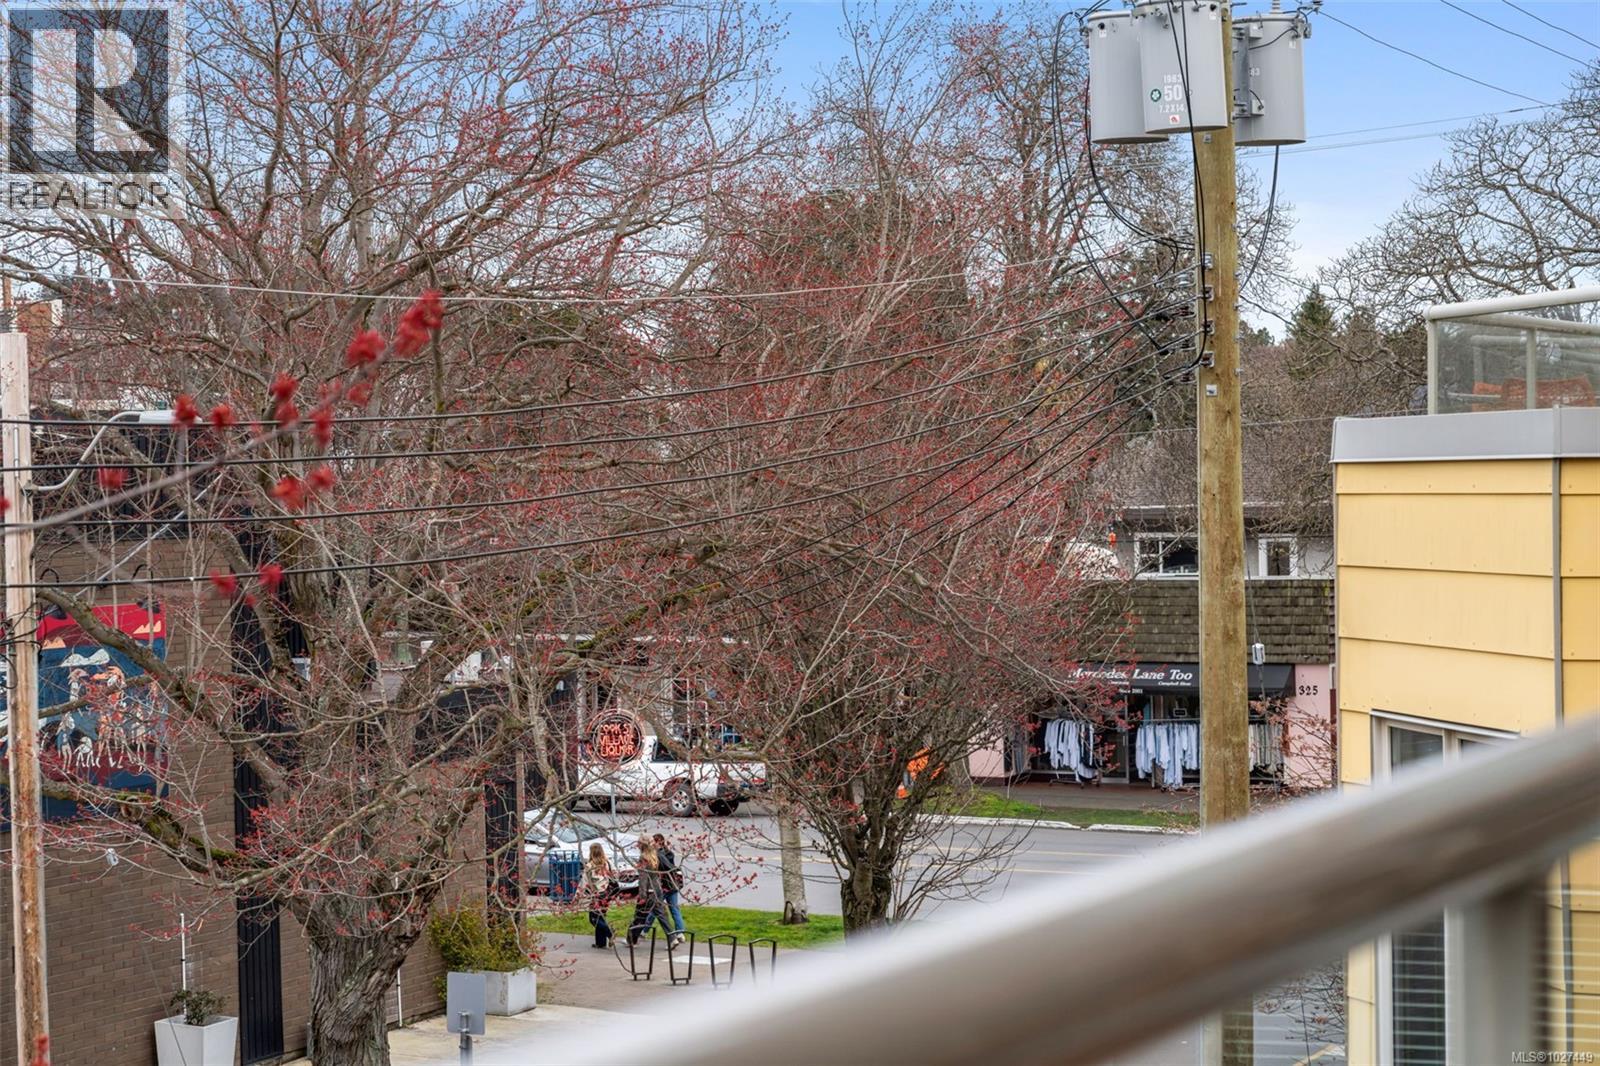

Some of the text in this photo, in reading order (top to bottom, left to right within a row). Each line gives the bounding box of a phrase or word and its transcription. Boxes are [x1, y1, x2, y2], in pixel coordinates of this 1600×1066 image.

[1164, 84, 1183, 101] 50
[1132, 668, 1164, 680] Lane
[1169, 668, 1193, 680] Too
[1298, 685, 1319, 696] 325
